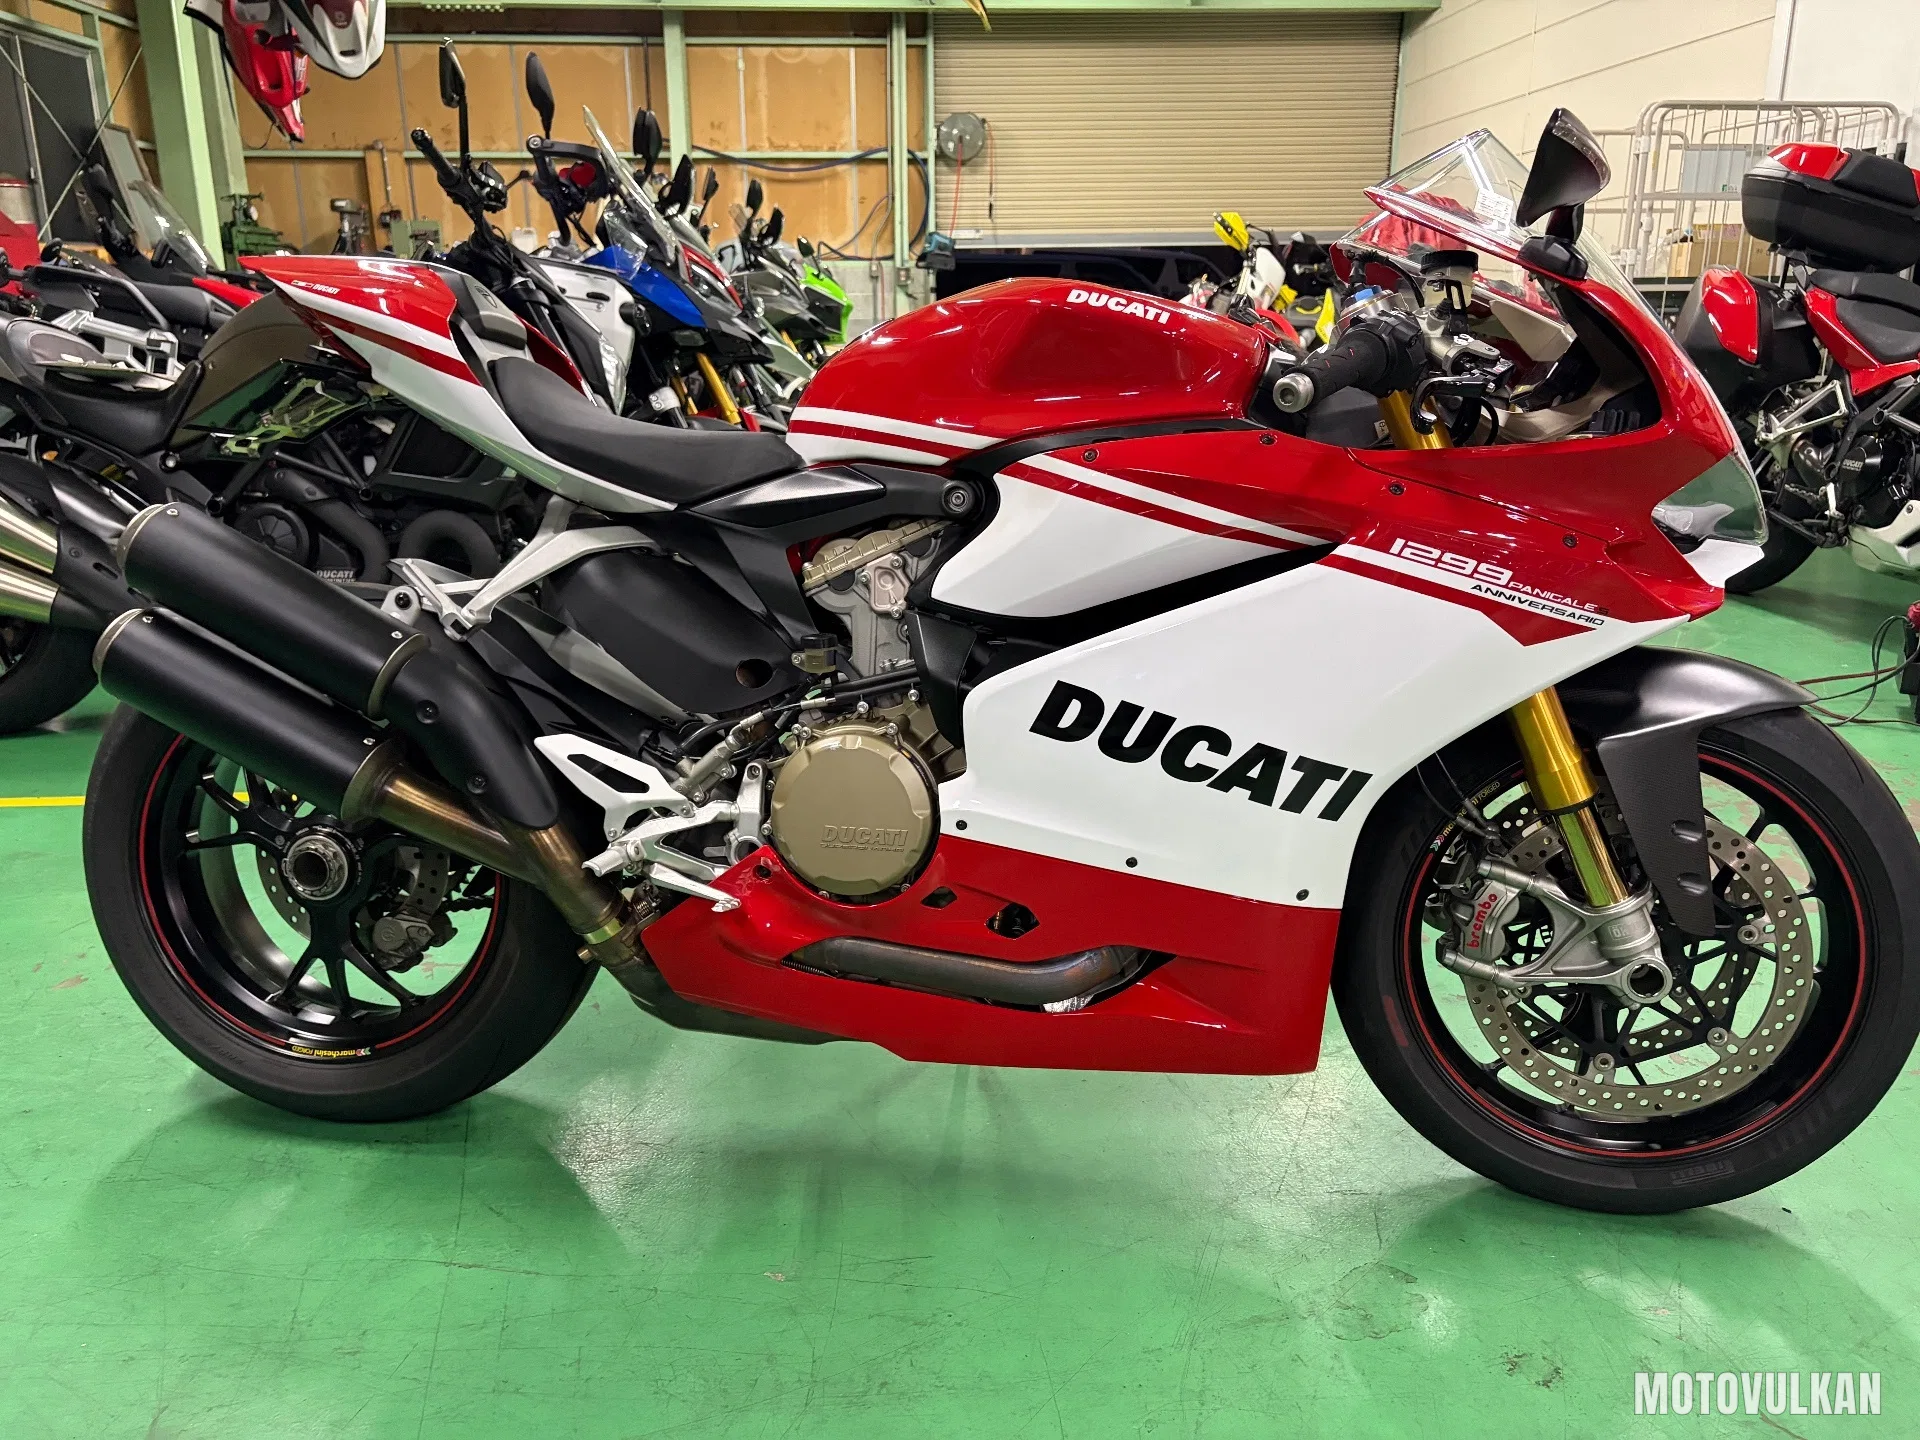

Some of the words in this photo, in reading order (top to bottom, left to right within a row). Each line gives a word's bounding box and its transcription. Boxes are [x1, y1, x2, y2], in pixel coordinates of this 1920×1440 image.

[312, 283, 341, 295] DUCATI
[1066, 289, 1170, 324] DUCATI
[316, 570, 354, 579] DUCATI
[1389, 537, 1513, 586] 1299
[1471, 584, 1605, 626] ANNIVERSARIO
[1029, 680, 1373, 822] DUCATI
[821, 824, 909, 847] DUCATI
[1467, 893, 1498, 948] brembo
[314, 1048, 356, 1058] marchesini
